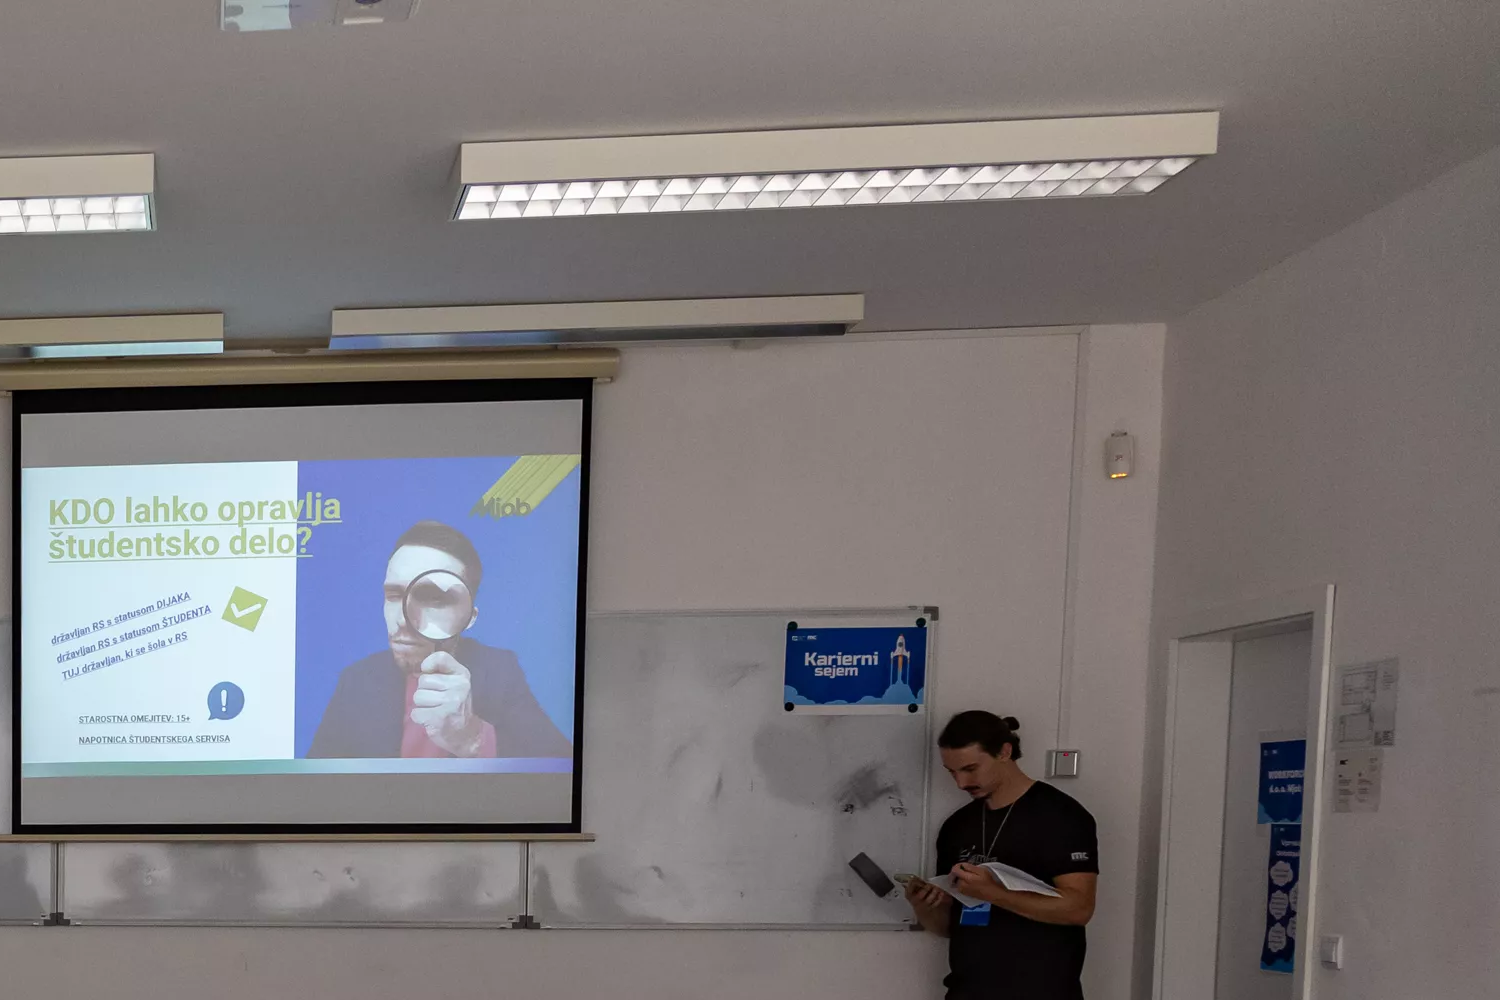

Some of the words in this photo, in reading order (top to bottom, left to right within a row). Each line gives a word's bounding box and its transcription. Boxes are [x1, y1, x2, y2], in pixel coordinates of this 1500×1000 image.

[49, 497, 115, 525] KDO
[125, 495, 208, 523] lahko
[217, 491, 341, 527] opravlja
[48, 529, 220, 560] študentsko
[229, 526, 312, 555] delo?
[51, 626, 91, 645] državljan
[92, 620, 105, 631] RS
[107, 618, 112, 626] s
[114, 604, 154, 624] statusom
[156, 591, 191, 609] DIJAKA
[57, 644, 96, 663] državljan
[98, 638, 111, 649] RS
[112, 637, 118, 645] s
[119, 623, 160, 642] statusom
[162, 605, 212, 628] ŠTUDENTA
[62, 667, 80, 680] TUJ
[82, 654, 124, 673] državljan,
[125, 649, 133, 659] ki
[135, 646, 146, 655] se
[148, 639, 166, 651] šola
[175, 631, 188, 642] RS
[804, 652, 879, 666] Karierni
[814, 665, 858, 678] sejem
[78, 715, 129, 723] STAROSTNA
[130, 715, 174, 723] OMEJITEV:
[176, 715, 191, 723] 15+
[78, 736, 127, 744] NAPOTNICA
[128, 734, 194, 743] ŠTUDENTSKEGA
[195, 735, 231, 743] SERVISA
